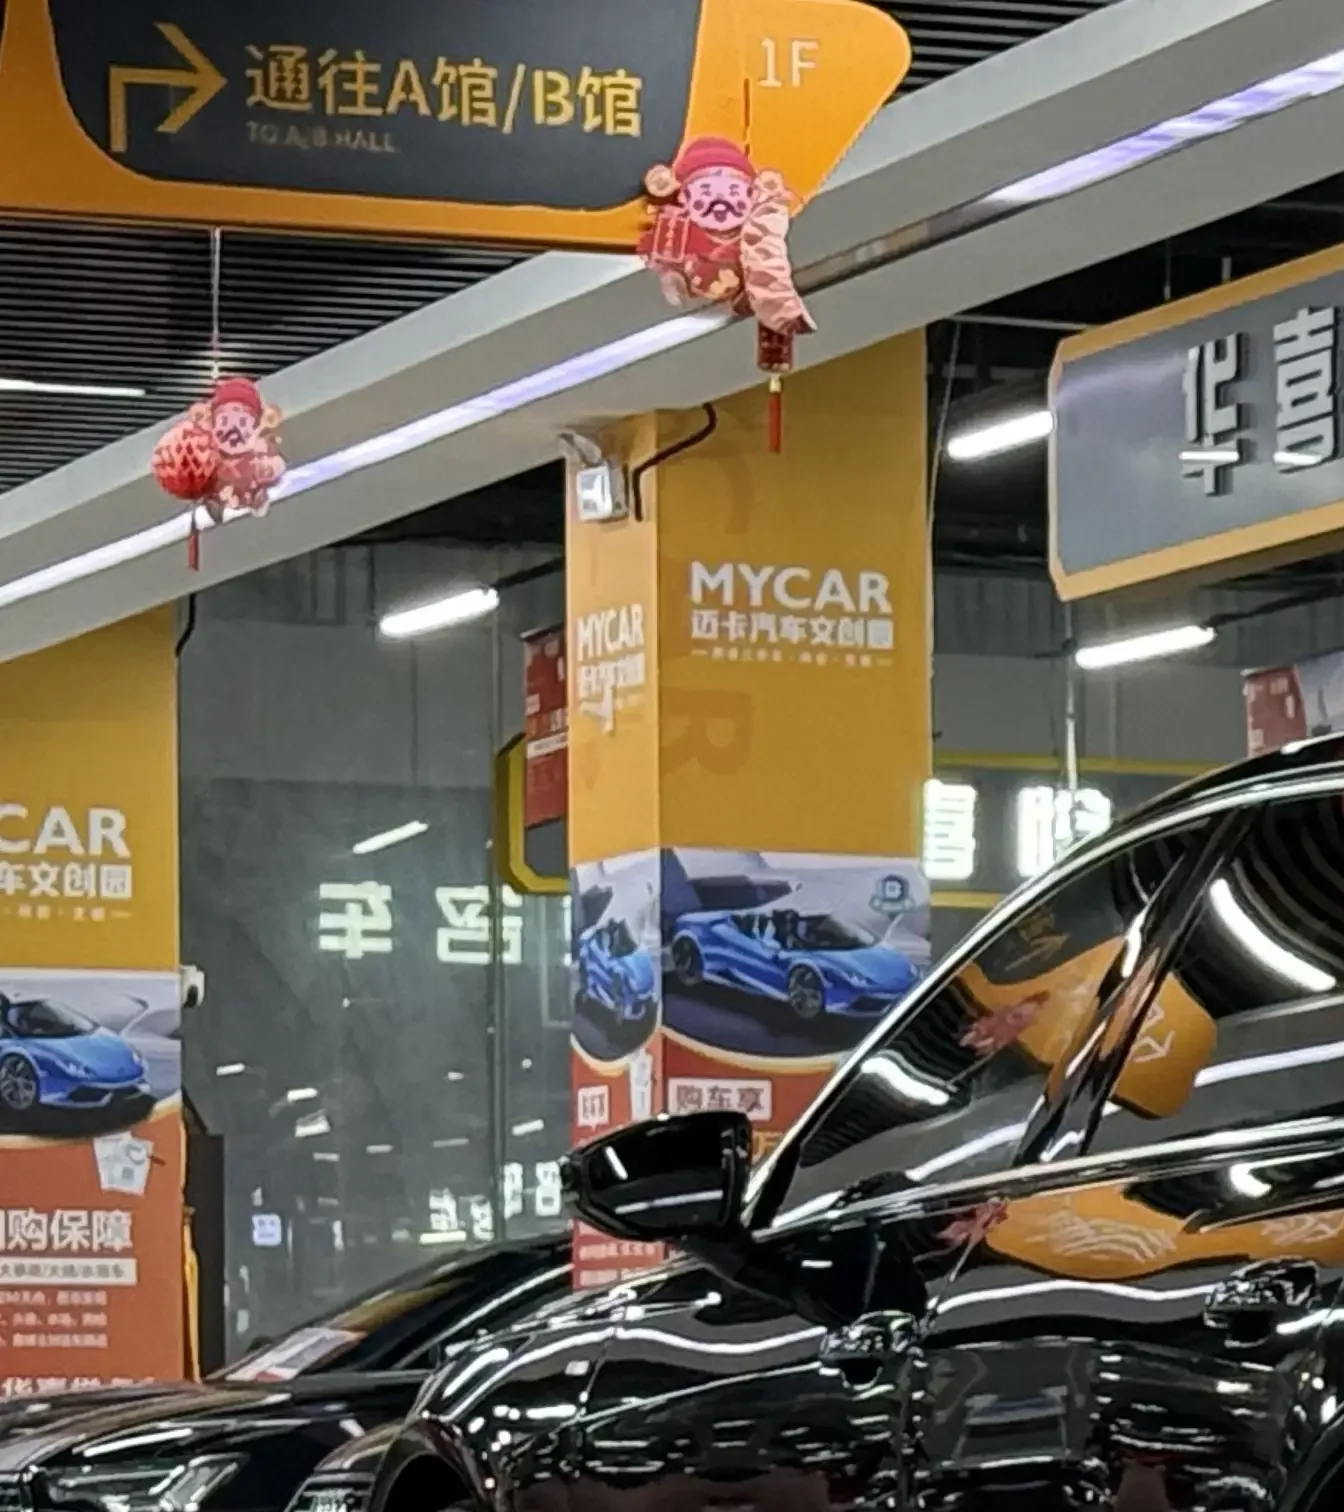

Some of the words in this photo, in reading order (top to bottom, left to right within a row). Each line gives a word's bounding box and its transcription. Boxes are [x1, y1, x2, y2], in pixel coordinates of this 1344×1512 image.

[758, 37, 819, 88] 1F
[244, 43, 642, 138] 通往A馆/B馆
[691, 561, 893, 613] MYCAR
[577, 604, 645, 661] MYCAR
[0, 803, 131, 858] CAR
[0, 1208, 133, 1252] 购保障
